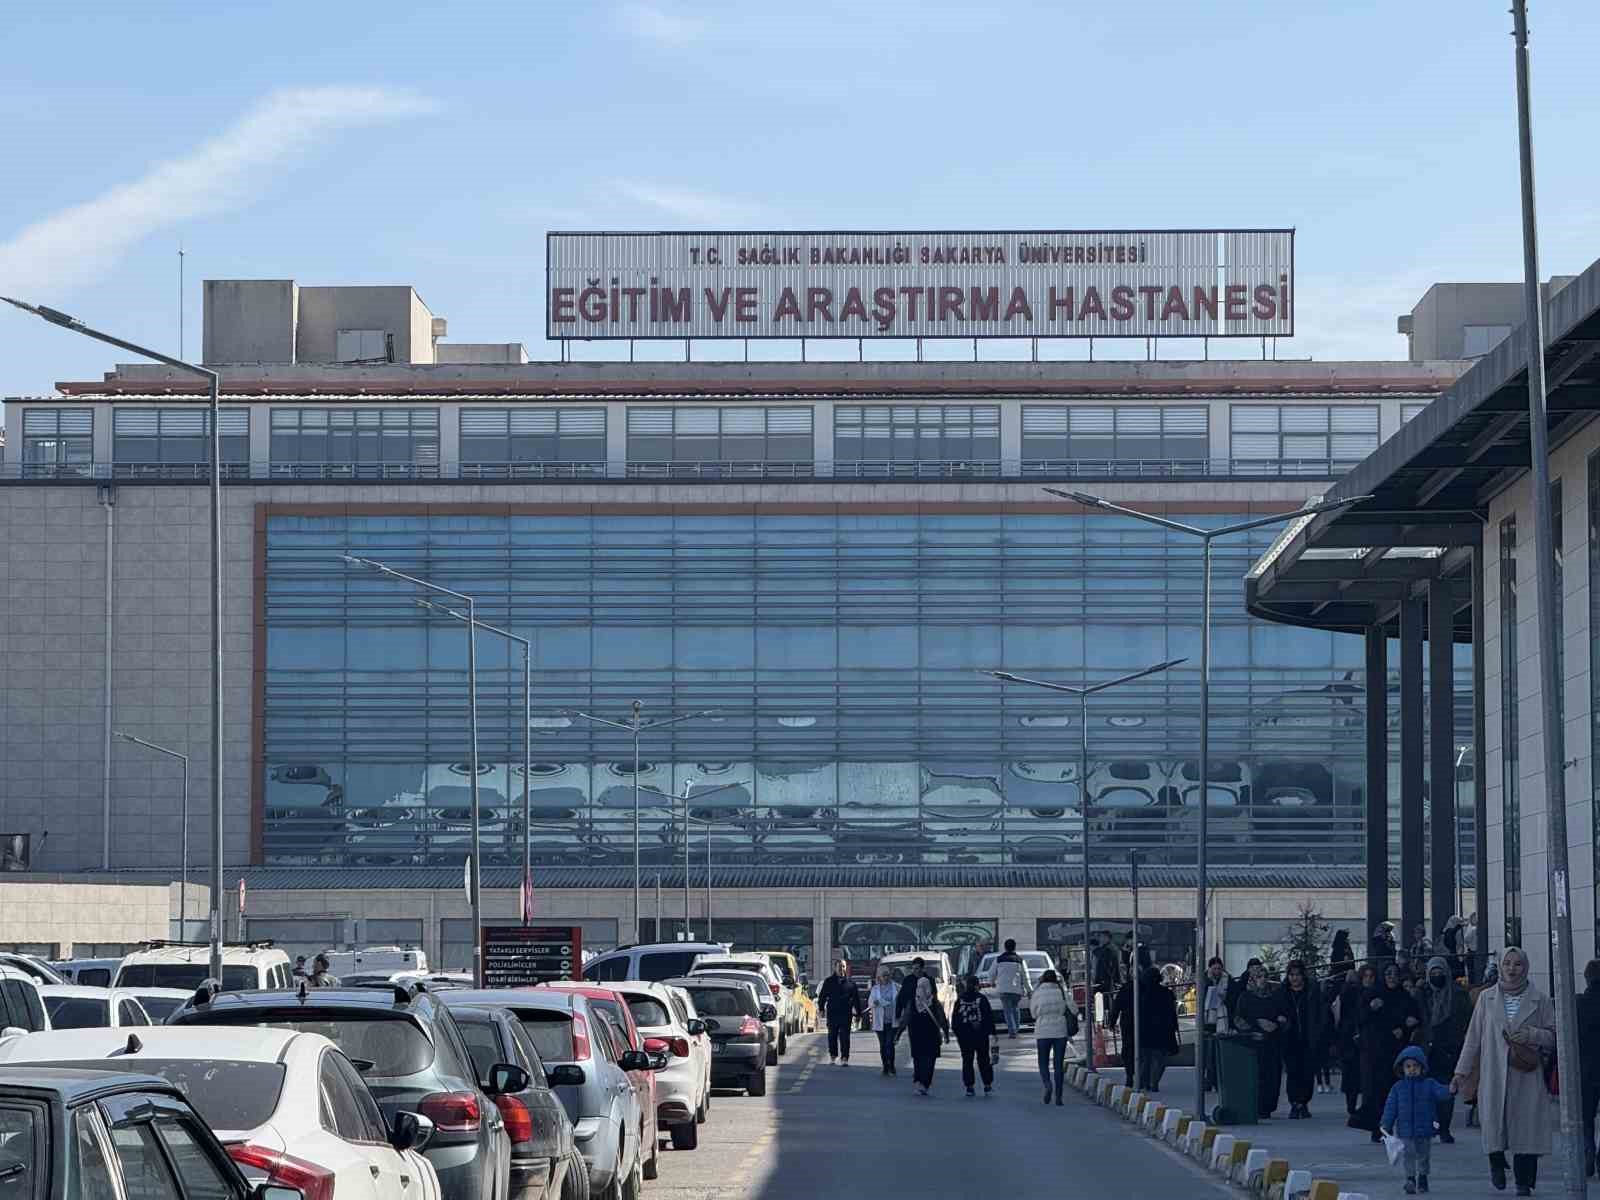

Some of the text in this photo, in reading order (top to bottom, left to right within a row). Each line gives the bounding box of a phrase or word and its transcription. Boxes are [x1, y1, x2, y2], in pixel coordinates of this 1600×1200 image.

[690, 242, 1146, 265] T.C. SAĞLIK BAKANLIĞI SAKARYA ÜNİVERSİTESİ
[551, 273, 1289, 332] EĞİTİM VE ARAŞTIRMA HASTANESİ
